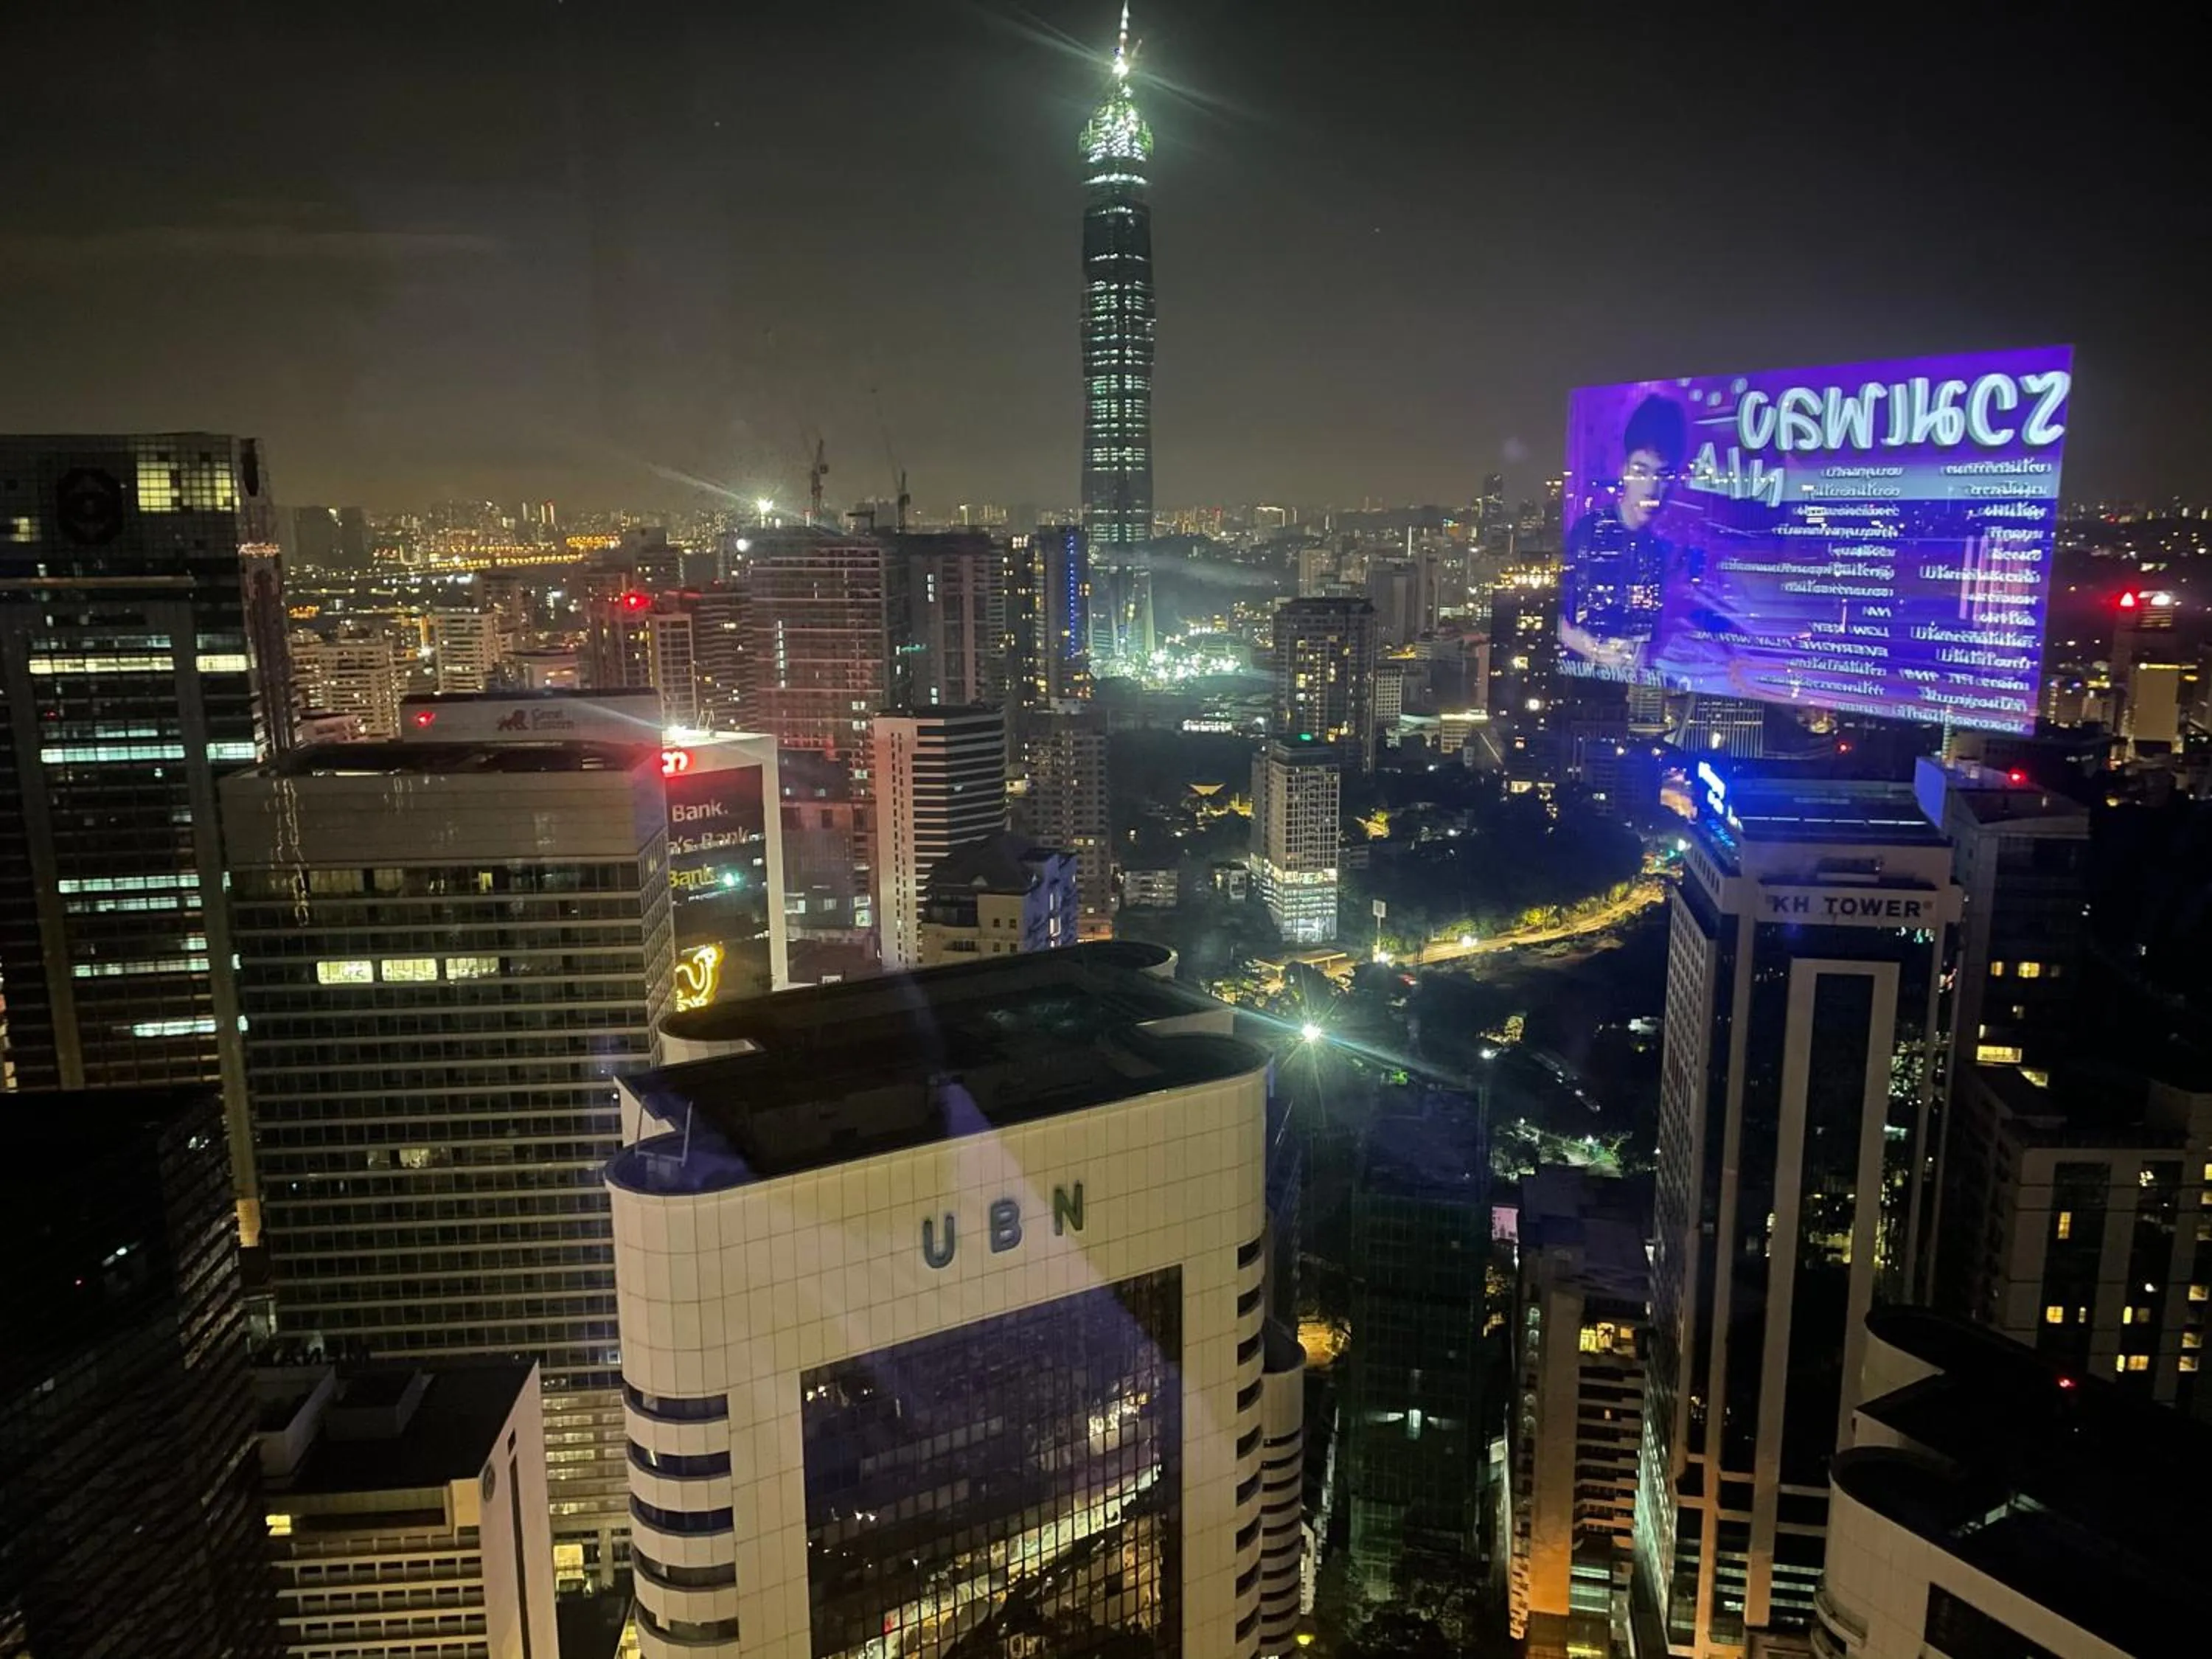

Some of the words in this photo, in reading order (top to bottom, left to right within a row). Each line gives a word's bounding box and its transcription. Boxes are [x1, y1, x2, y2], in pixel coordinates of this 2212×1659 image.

[672, 799, 728, 822] Bank.
[1773, 895, 1810, 913] KH
[1825, 897, 1921, 917] TOWER
[922, 1180, 1084, 1269] UBN
